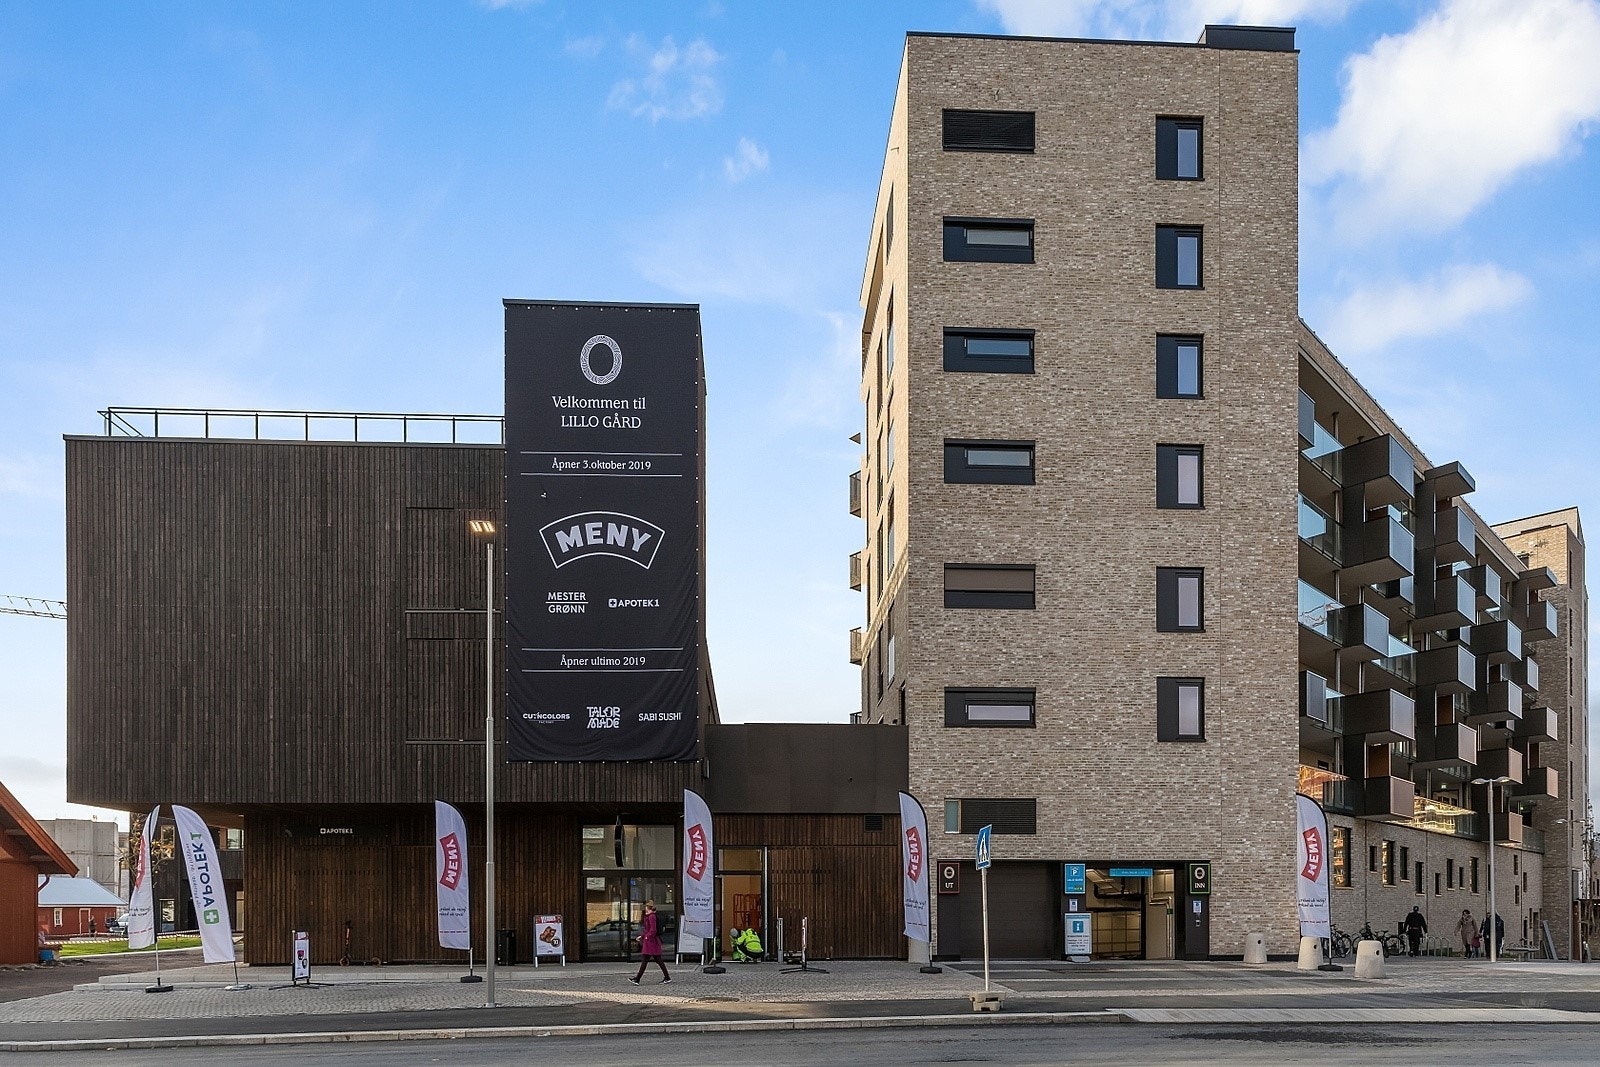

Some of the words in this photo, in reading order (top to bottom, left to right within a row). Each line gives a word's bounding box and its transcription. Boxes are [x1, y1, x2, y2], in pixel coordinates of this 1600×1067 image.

[552, 396, 629, 410] Velkommen
[632, 397, 646, 410] til
[561, 415, 599, 428] LILLO
[602, 412, 642, 429] GÅRD
[552, 457, 580, 471] Åpner
[583, 460, 627, 471] 3.oktober
[628, 461, 652, 471] 2019
[554, 521, 652, 553] MENY
[548, 592, 587, 601] MESTER
[548, 604, 585, 614] GRØNN
[560, 654, 589, 668] Åpner
[591, 656, 621, 666] ultimo
[623, 656, 646, 667] 2019
[638, 712, 658, 722] SABI
[658, 711, 682, 722] SUSHI
